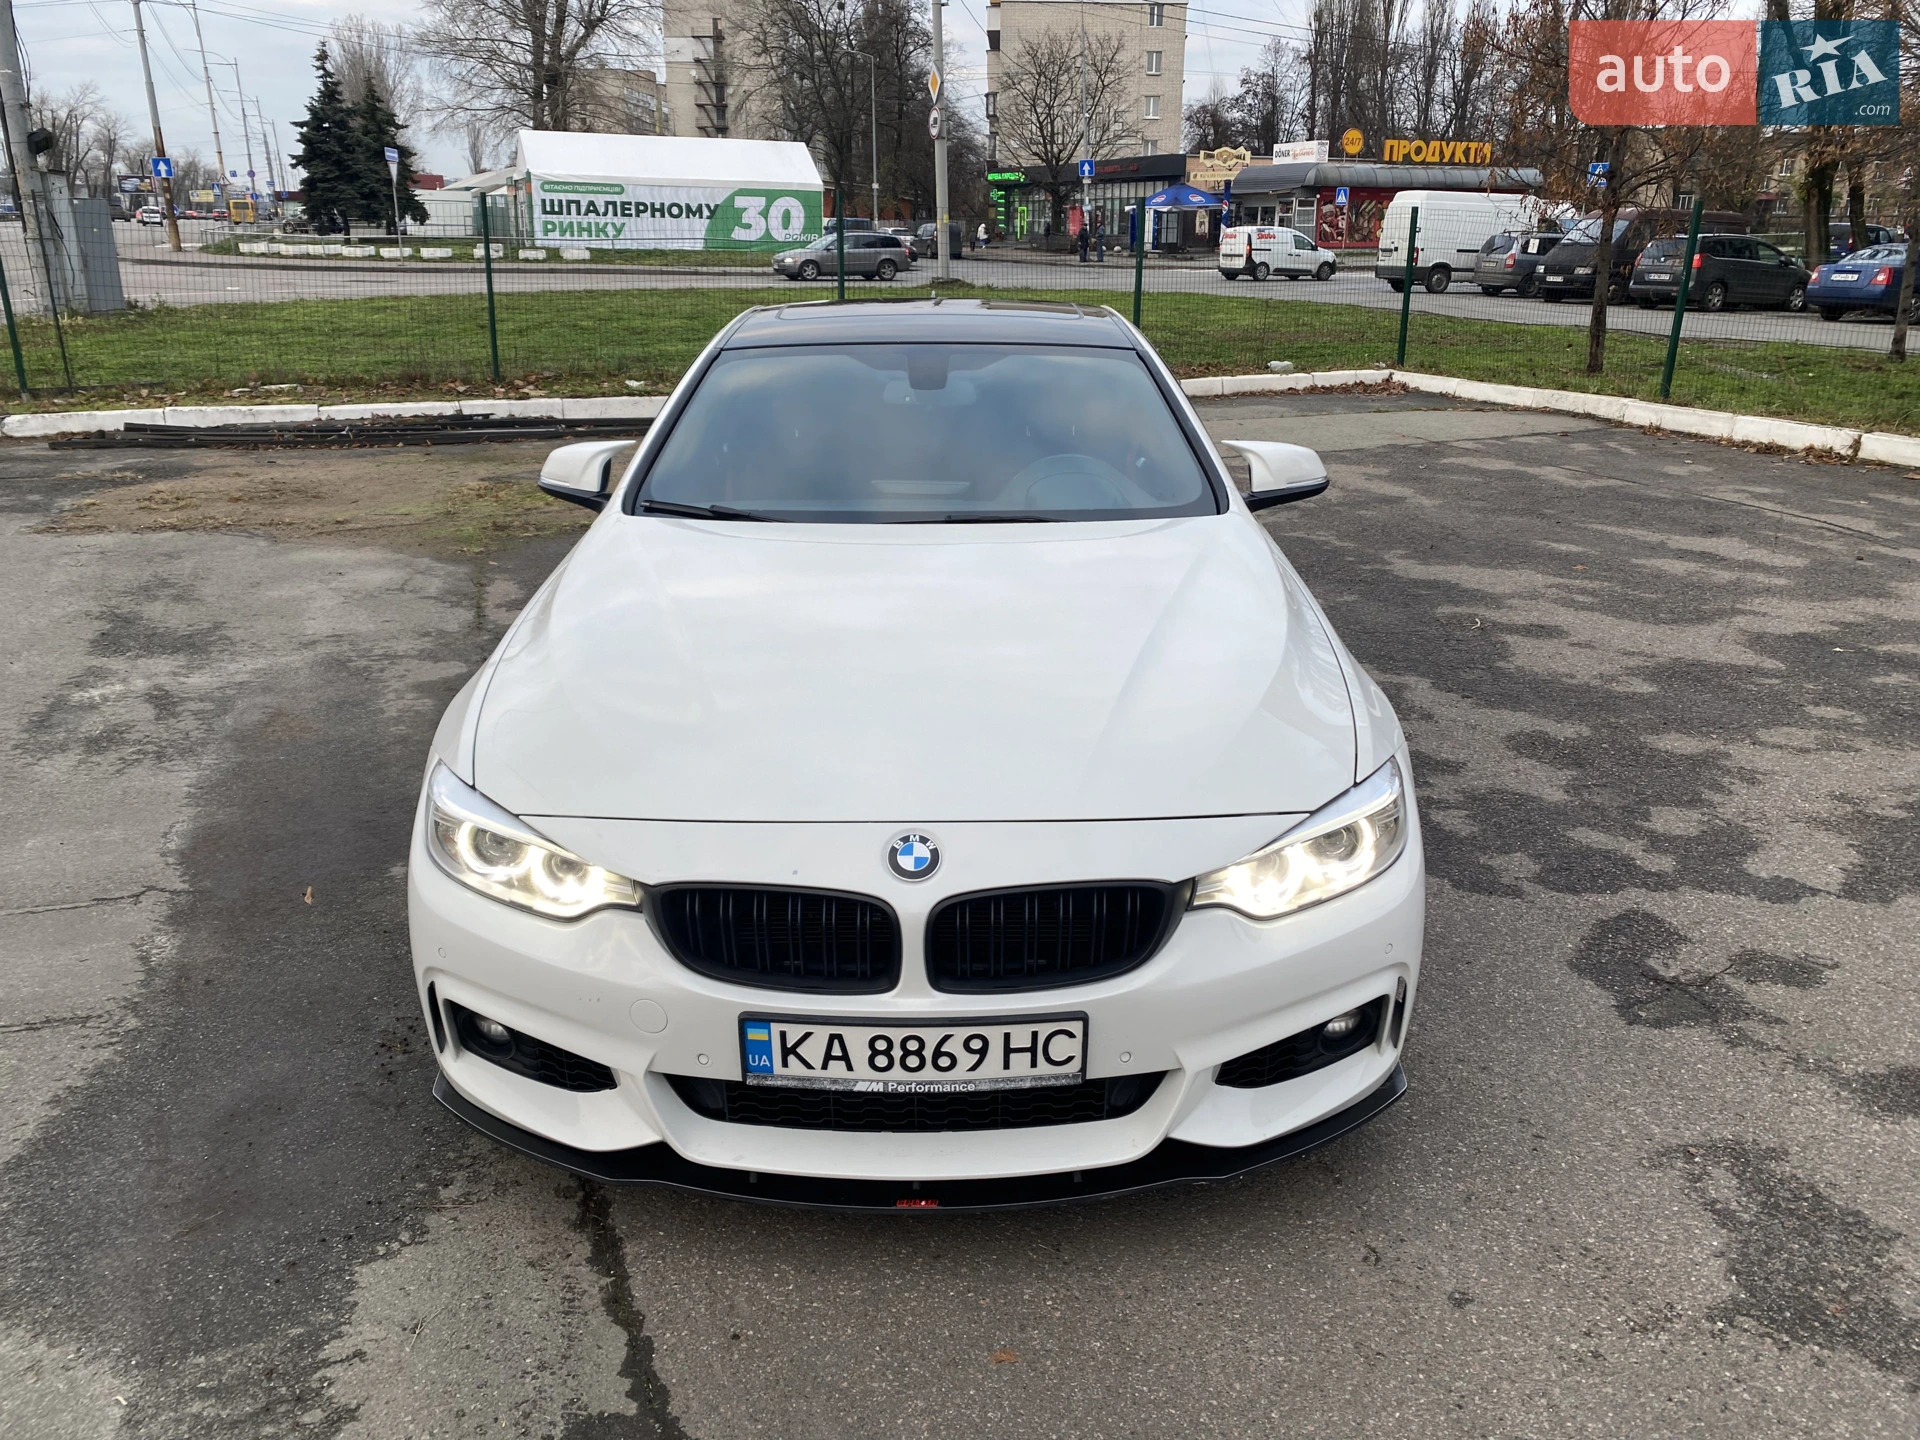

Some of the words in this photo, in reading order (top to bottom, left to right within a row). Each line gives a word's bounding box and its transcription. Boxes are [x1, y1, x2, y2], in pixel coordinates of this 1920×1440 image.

[1345, 137, 1362, 147] 24/7
[1274, 148, 1291, 158] DÖNER
[541, 198, 720, 220] ШПАЛЕРНОМУ
[731, 196, 804, 242] 30
[542, 220, 626, 239] РИНКУ
[892, 834, 937, 850] BMW
[779, 1029, 854, 1072] KA
[867, 1033, 990, 1073] 8869
[1002, 1028, 1077, 1071] HC
[749, 1054, 770, 1067] UA
[888, 1081, 976, 1093] Performance
